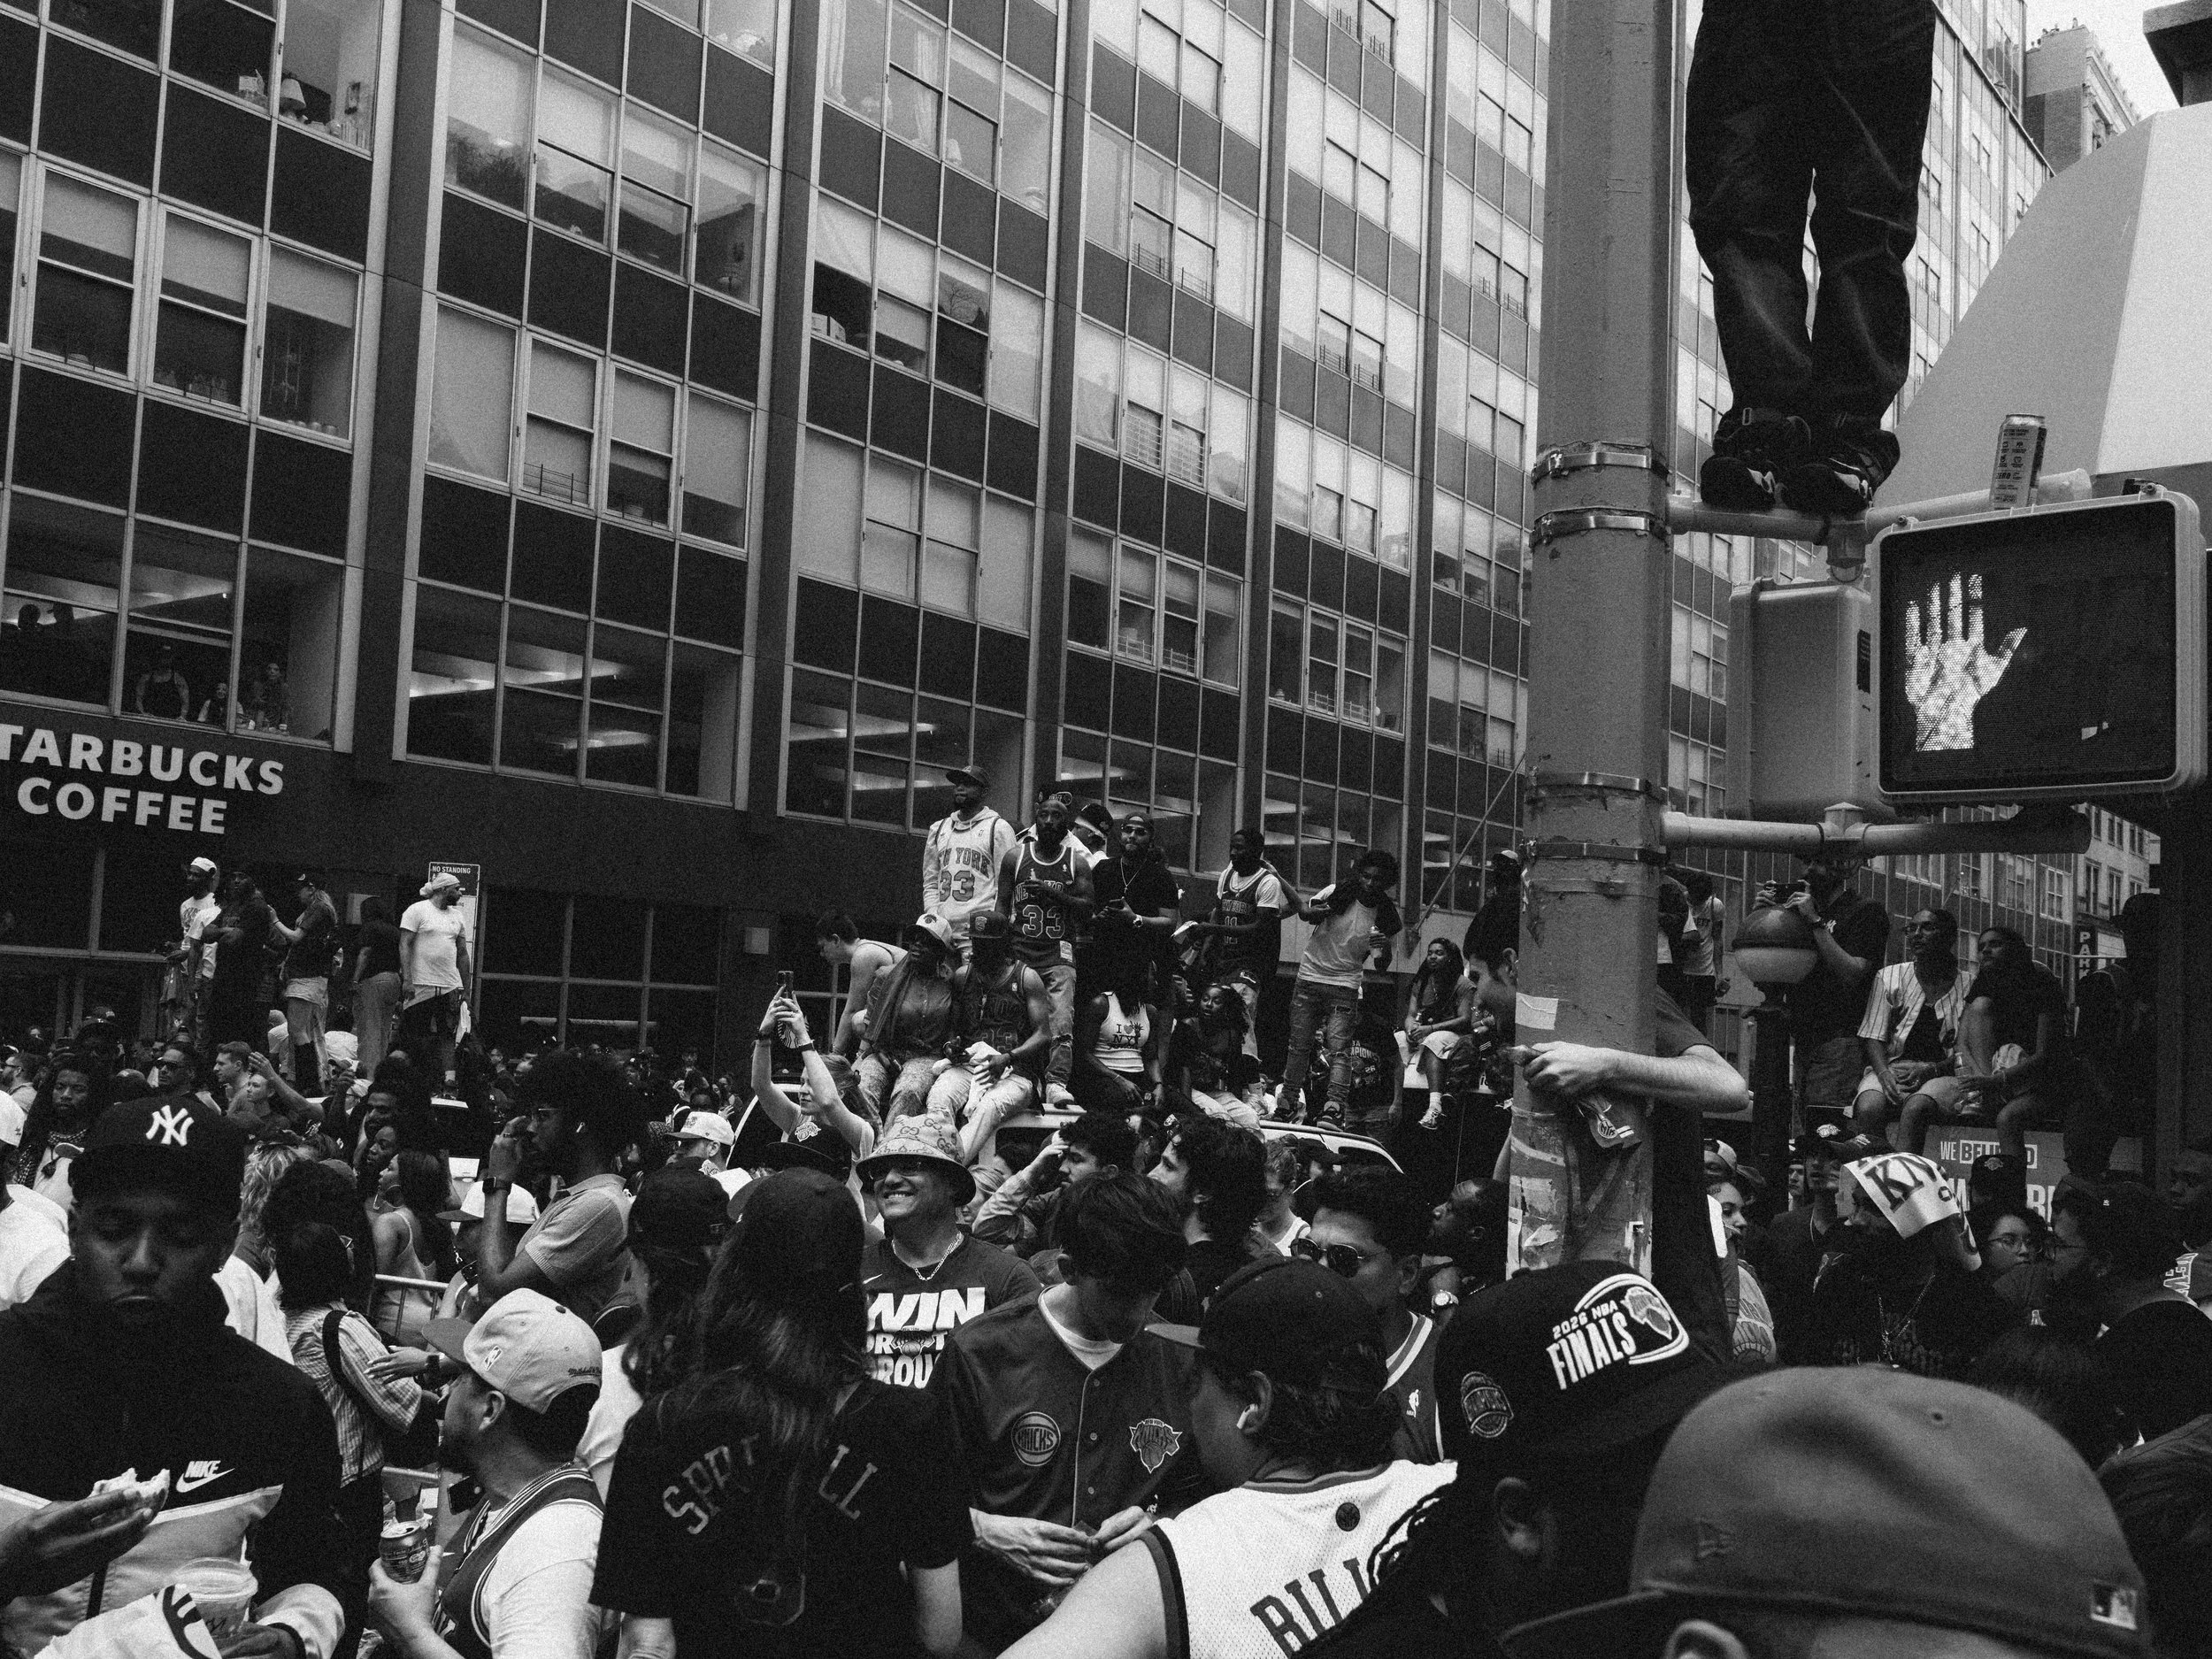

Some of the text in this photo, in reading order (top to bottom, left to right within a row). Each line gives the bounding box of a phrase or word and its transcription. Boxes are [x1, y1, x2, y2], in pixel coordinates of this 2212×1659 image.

[0, 725, 284, 794] TARBUCKS
[18, 777, 227, 834] COFFEE
[442, 865, 472, 874] STANDING
[939, 871, 975, 902] 33
[1022, 903, 1065, 939] 33
[145, 1104, 195, 1147] NY
[1940, 1141, 1956, 1161] WE
[865, 1286, 986, 1332] WIN
[1552, 1311, 1588, 1340] 2026
[1591, 1300, 1618, 1319] NBA
[1546, 1311, 1637, 1390] FINALS
[1017, 1427, 1055, 1452] KNICKS
[184, 1460, 222, 1479] NIKE
